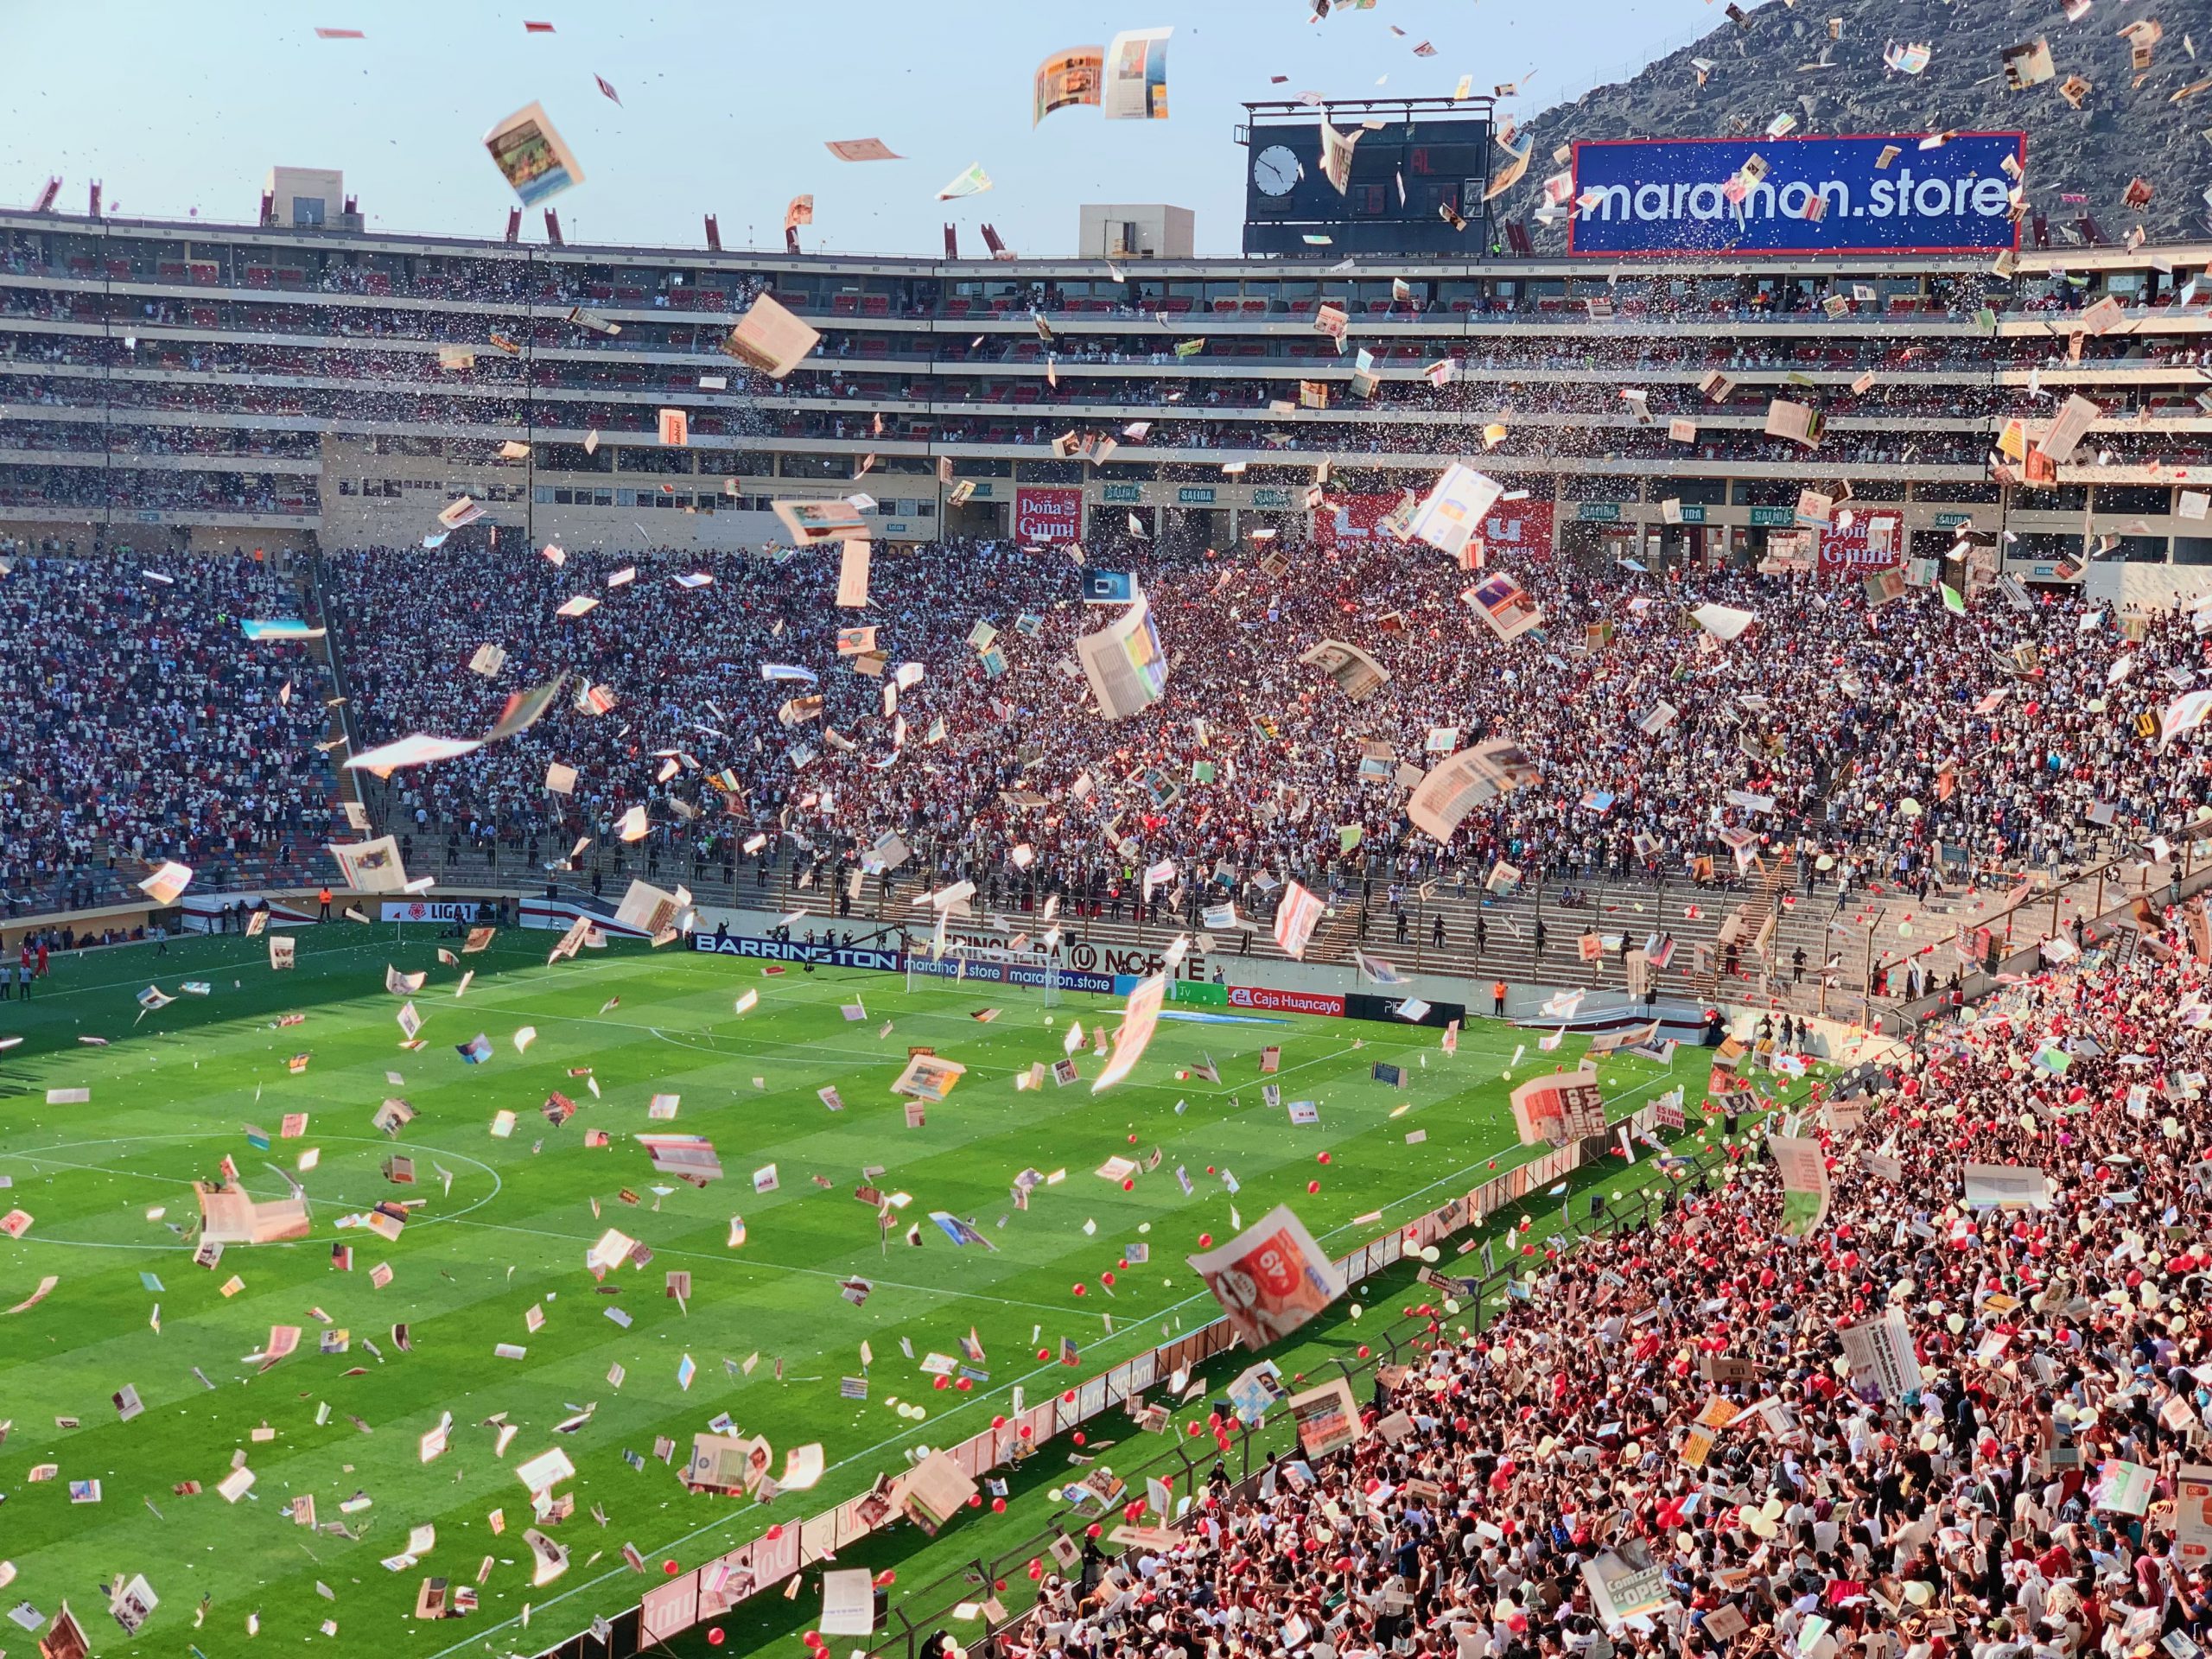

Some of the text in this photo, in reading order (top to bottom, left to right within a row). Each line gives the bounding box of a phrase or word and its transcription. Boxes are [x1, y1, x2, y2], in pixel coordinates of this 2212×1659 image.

[1580, 168, 2007, 221] marahon.store
[1181, 489, 1211, 501] SALIDA
[1021, 499, 1062, 516] Doña
[1753, 509, 1791, 524] SALIDA
[1019, 518, 1075, 538] Gumi
[1826, 519, 1867, 540] Doñ
[431, 905, 471, 919] LIGA1
[696, 935, 897, 970] BARRINGTON
[904, 957, 1001, 979] maratho.store
[1253, 991, 1340, 1014] Caja Huancayo
[1656, 1105, 1667, 1114] ES
[1874, 1348, 1893, 1389] peruanos
[1878, 1324, 1892, 1355] Vuelve
[1890, 1363, 1904, 1392] sorteo
[1209, 1509, 1220, 1520] 10
[1608, 1564, 1660, 1593] Comizzo
